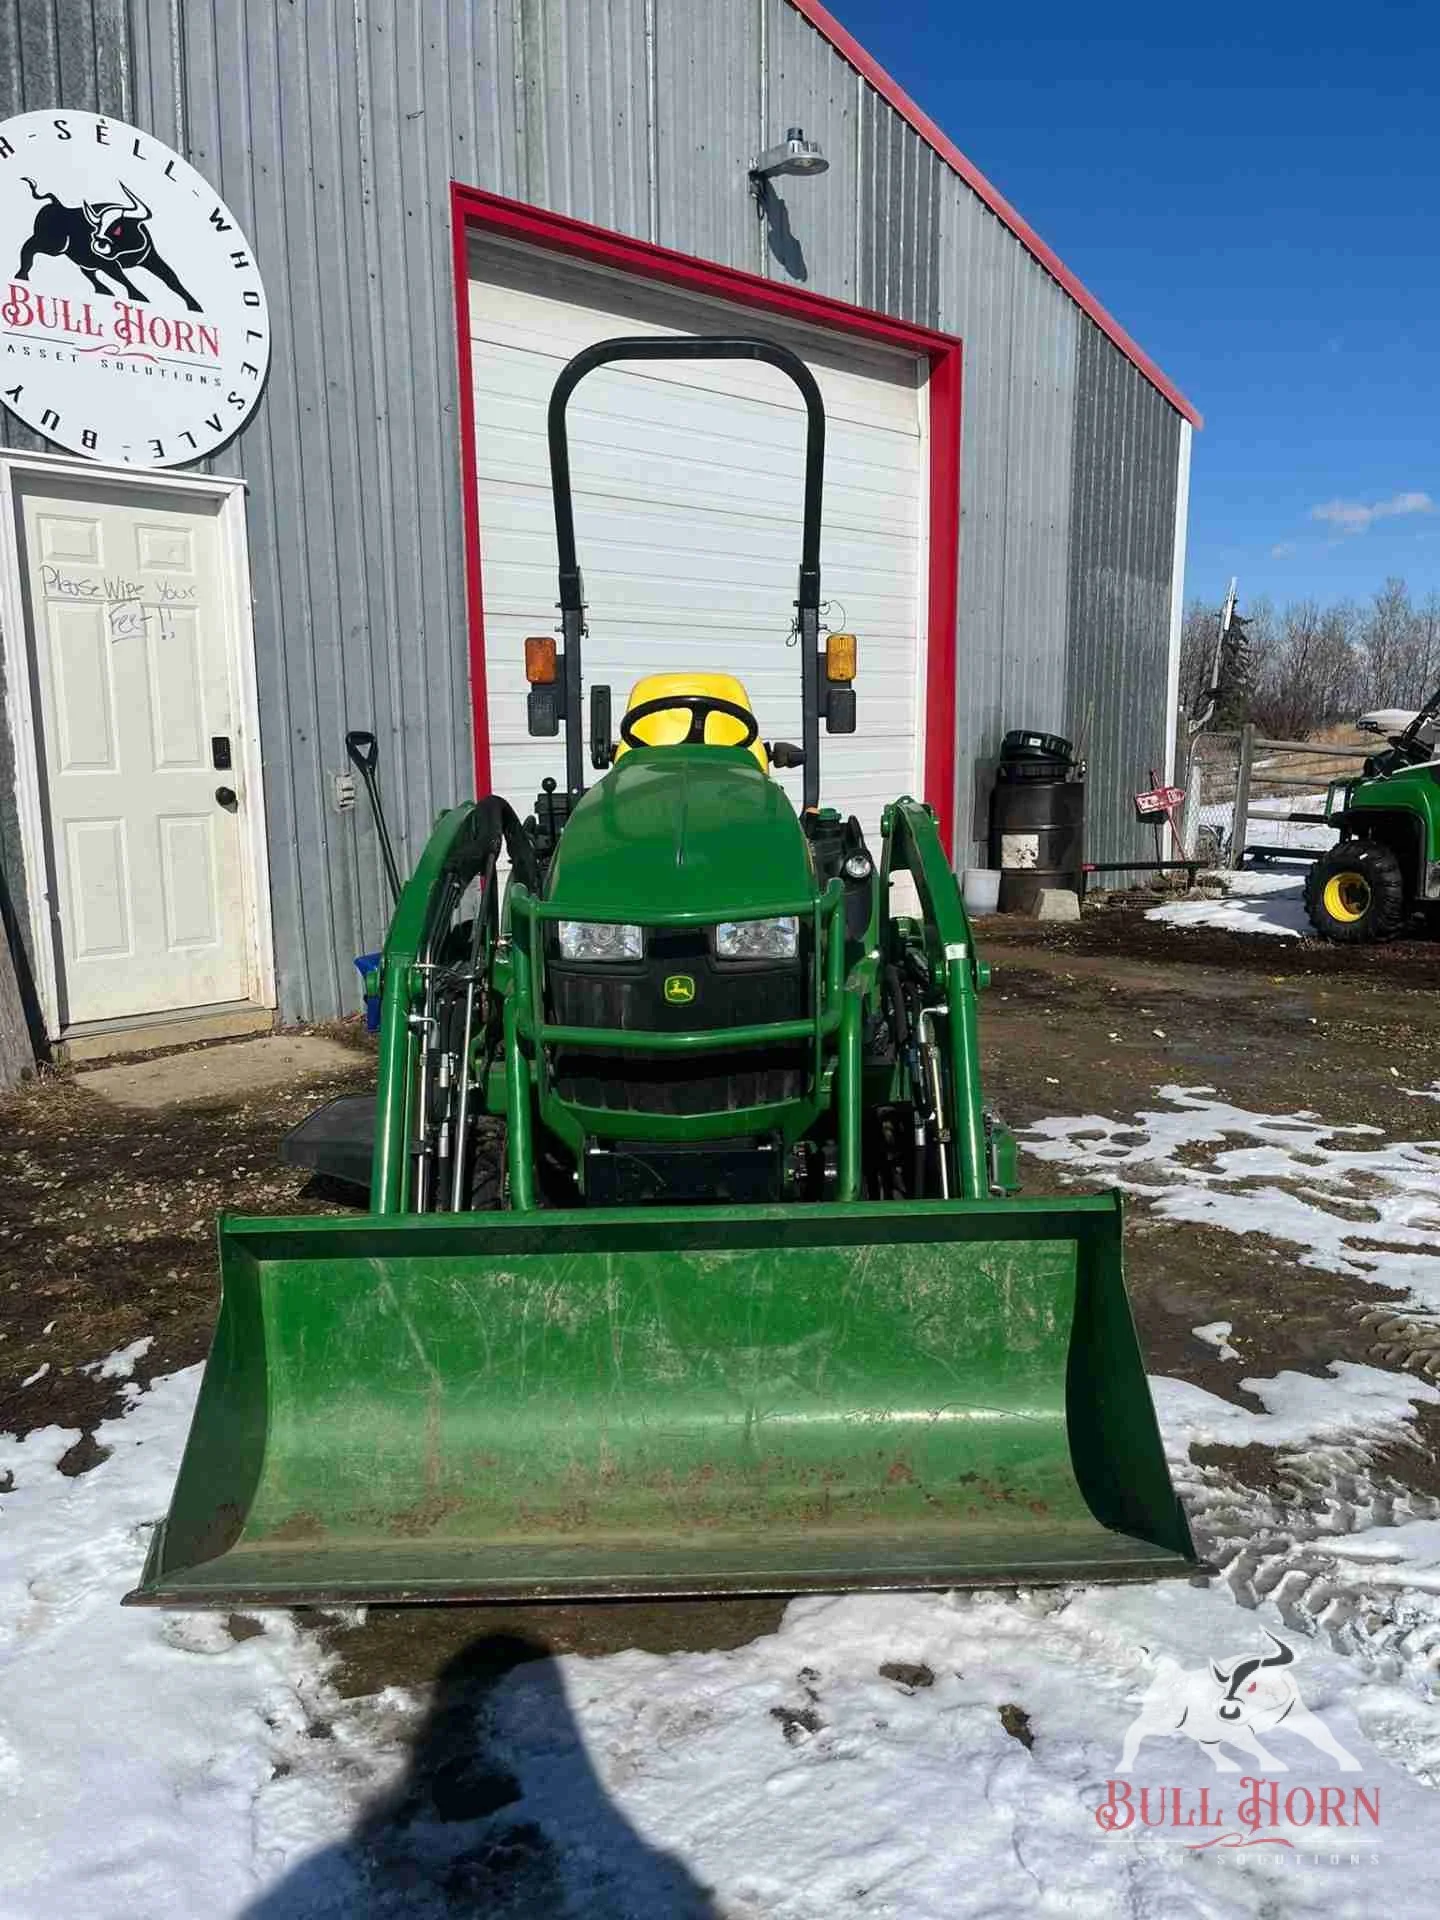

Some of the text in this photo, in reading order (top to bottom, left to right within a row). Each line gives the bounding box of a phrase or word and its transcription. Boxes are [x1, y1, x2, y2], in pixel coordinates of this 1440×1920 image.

[1, 284, 220, 358] BULL HORN
[7, 343, 222, 387] ASSET SOLUTIONS
[4, 384, 99, 450] BUY
[40, 565, 100, 598] Please
[104, 576, 144, 598] Wipe
